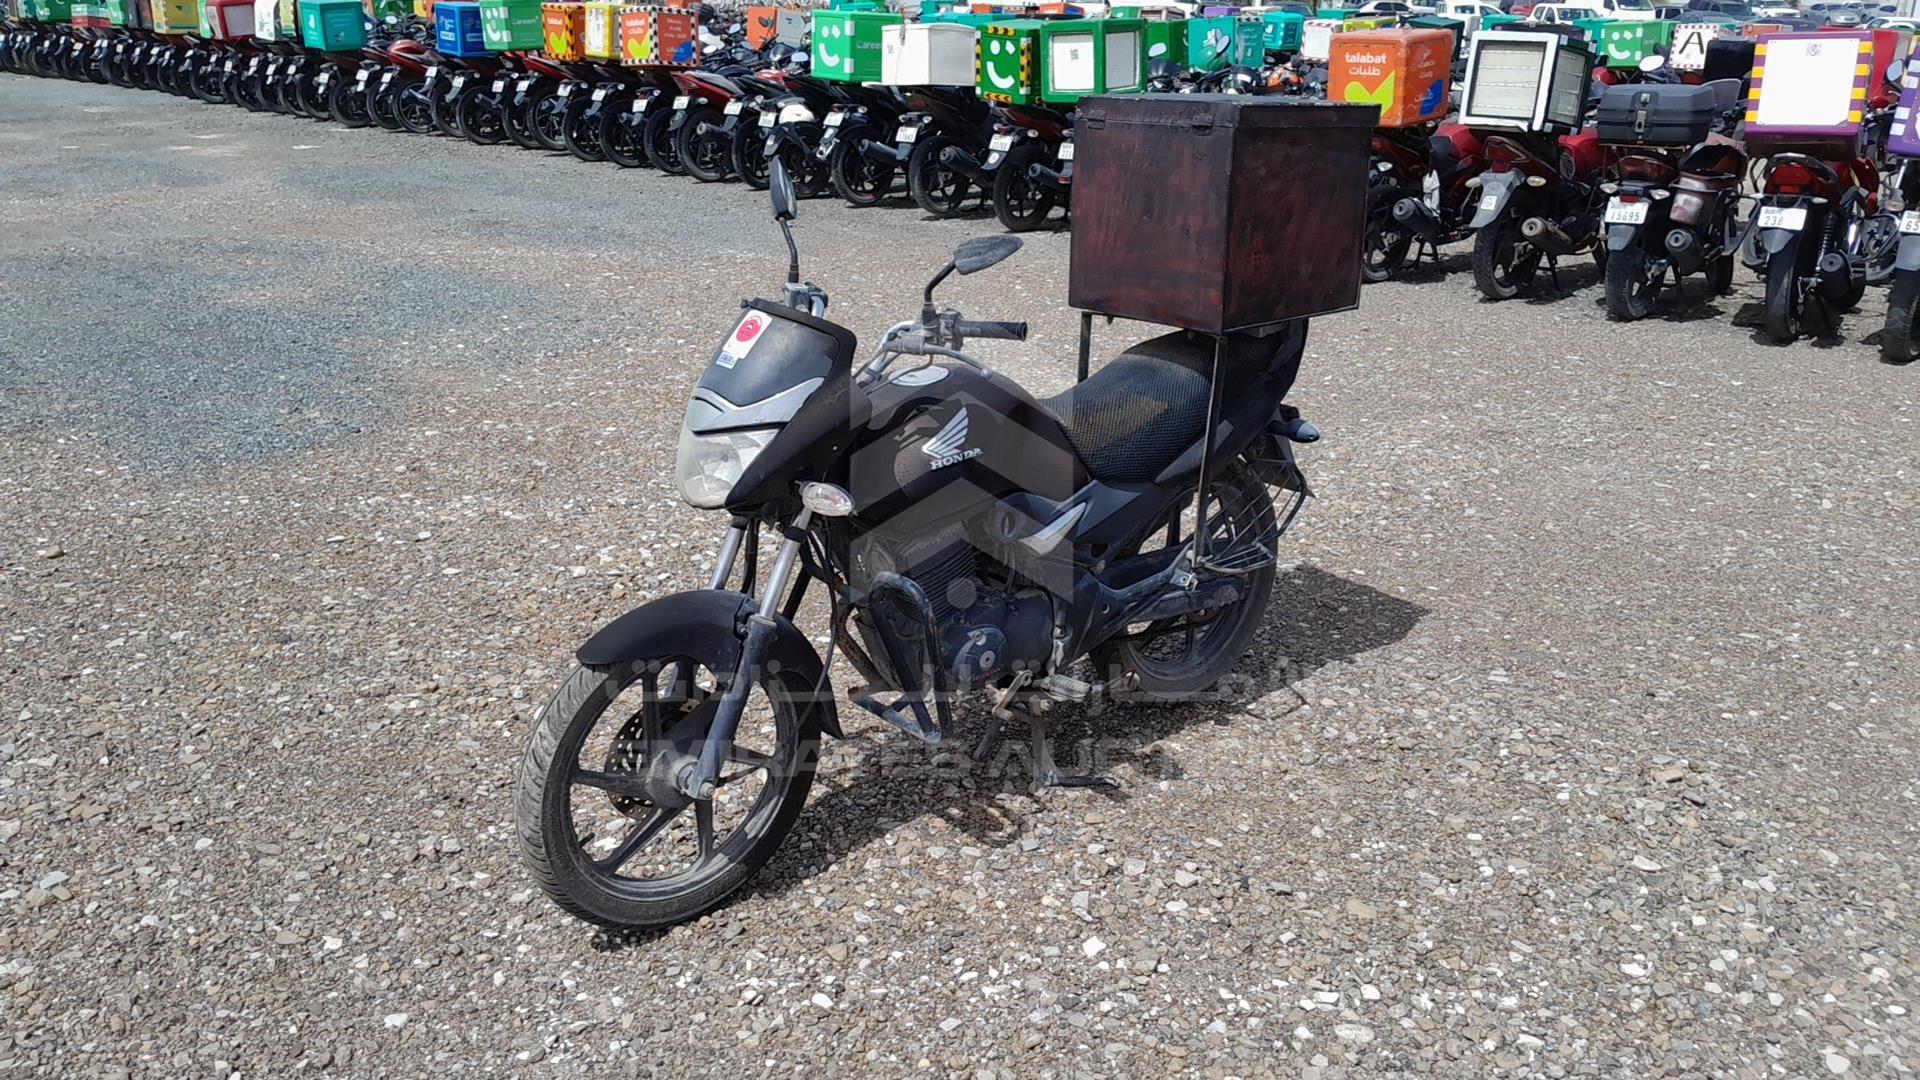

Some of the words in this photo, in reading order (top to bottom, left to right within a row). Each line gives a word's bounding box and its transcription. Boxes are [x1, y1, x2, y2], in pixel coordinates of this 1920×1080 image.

[856, 40, 882, 49] Caree
[1678, 31, 1704, 54] A
[1344, 51, 1387, 64] talabat
[1348, 65, 1381, 78] طلبات
[929, 448, 984, 470] HONDA
